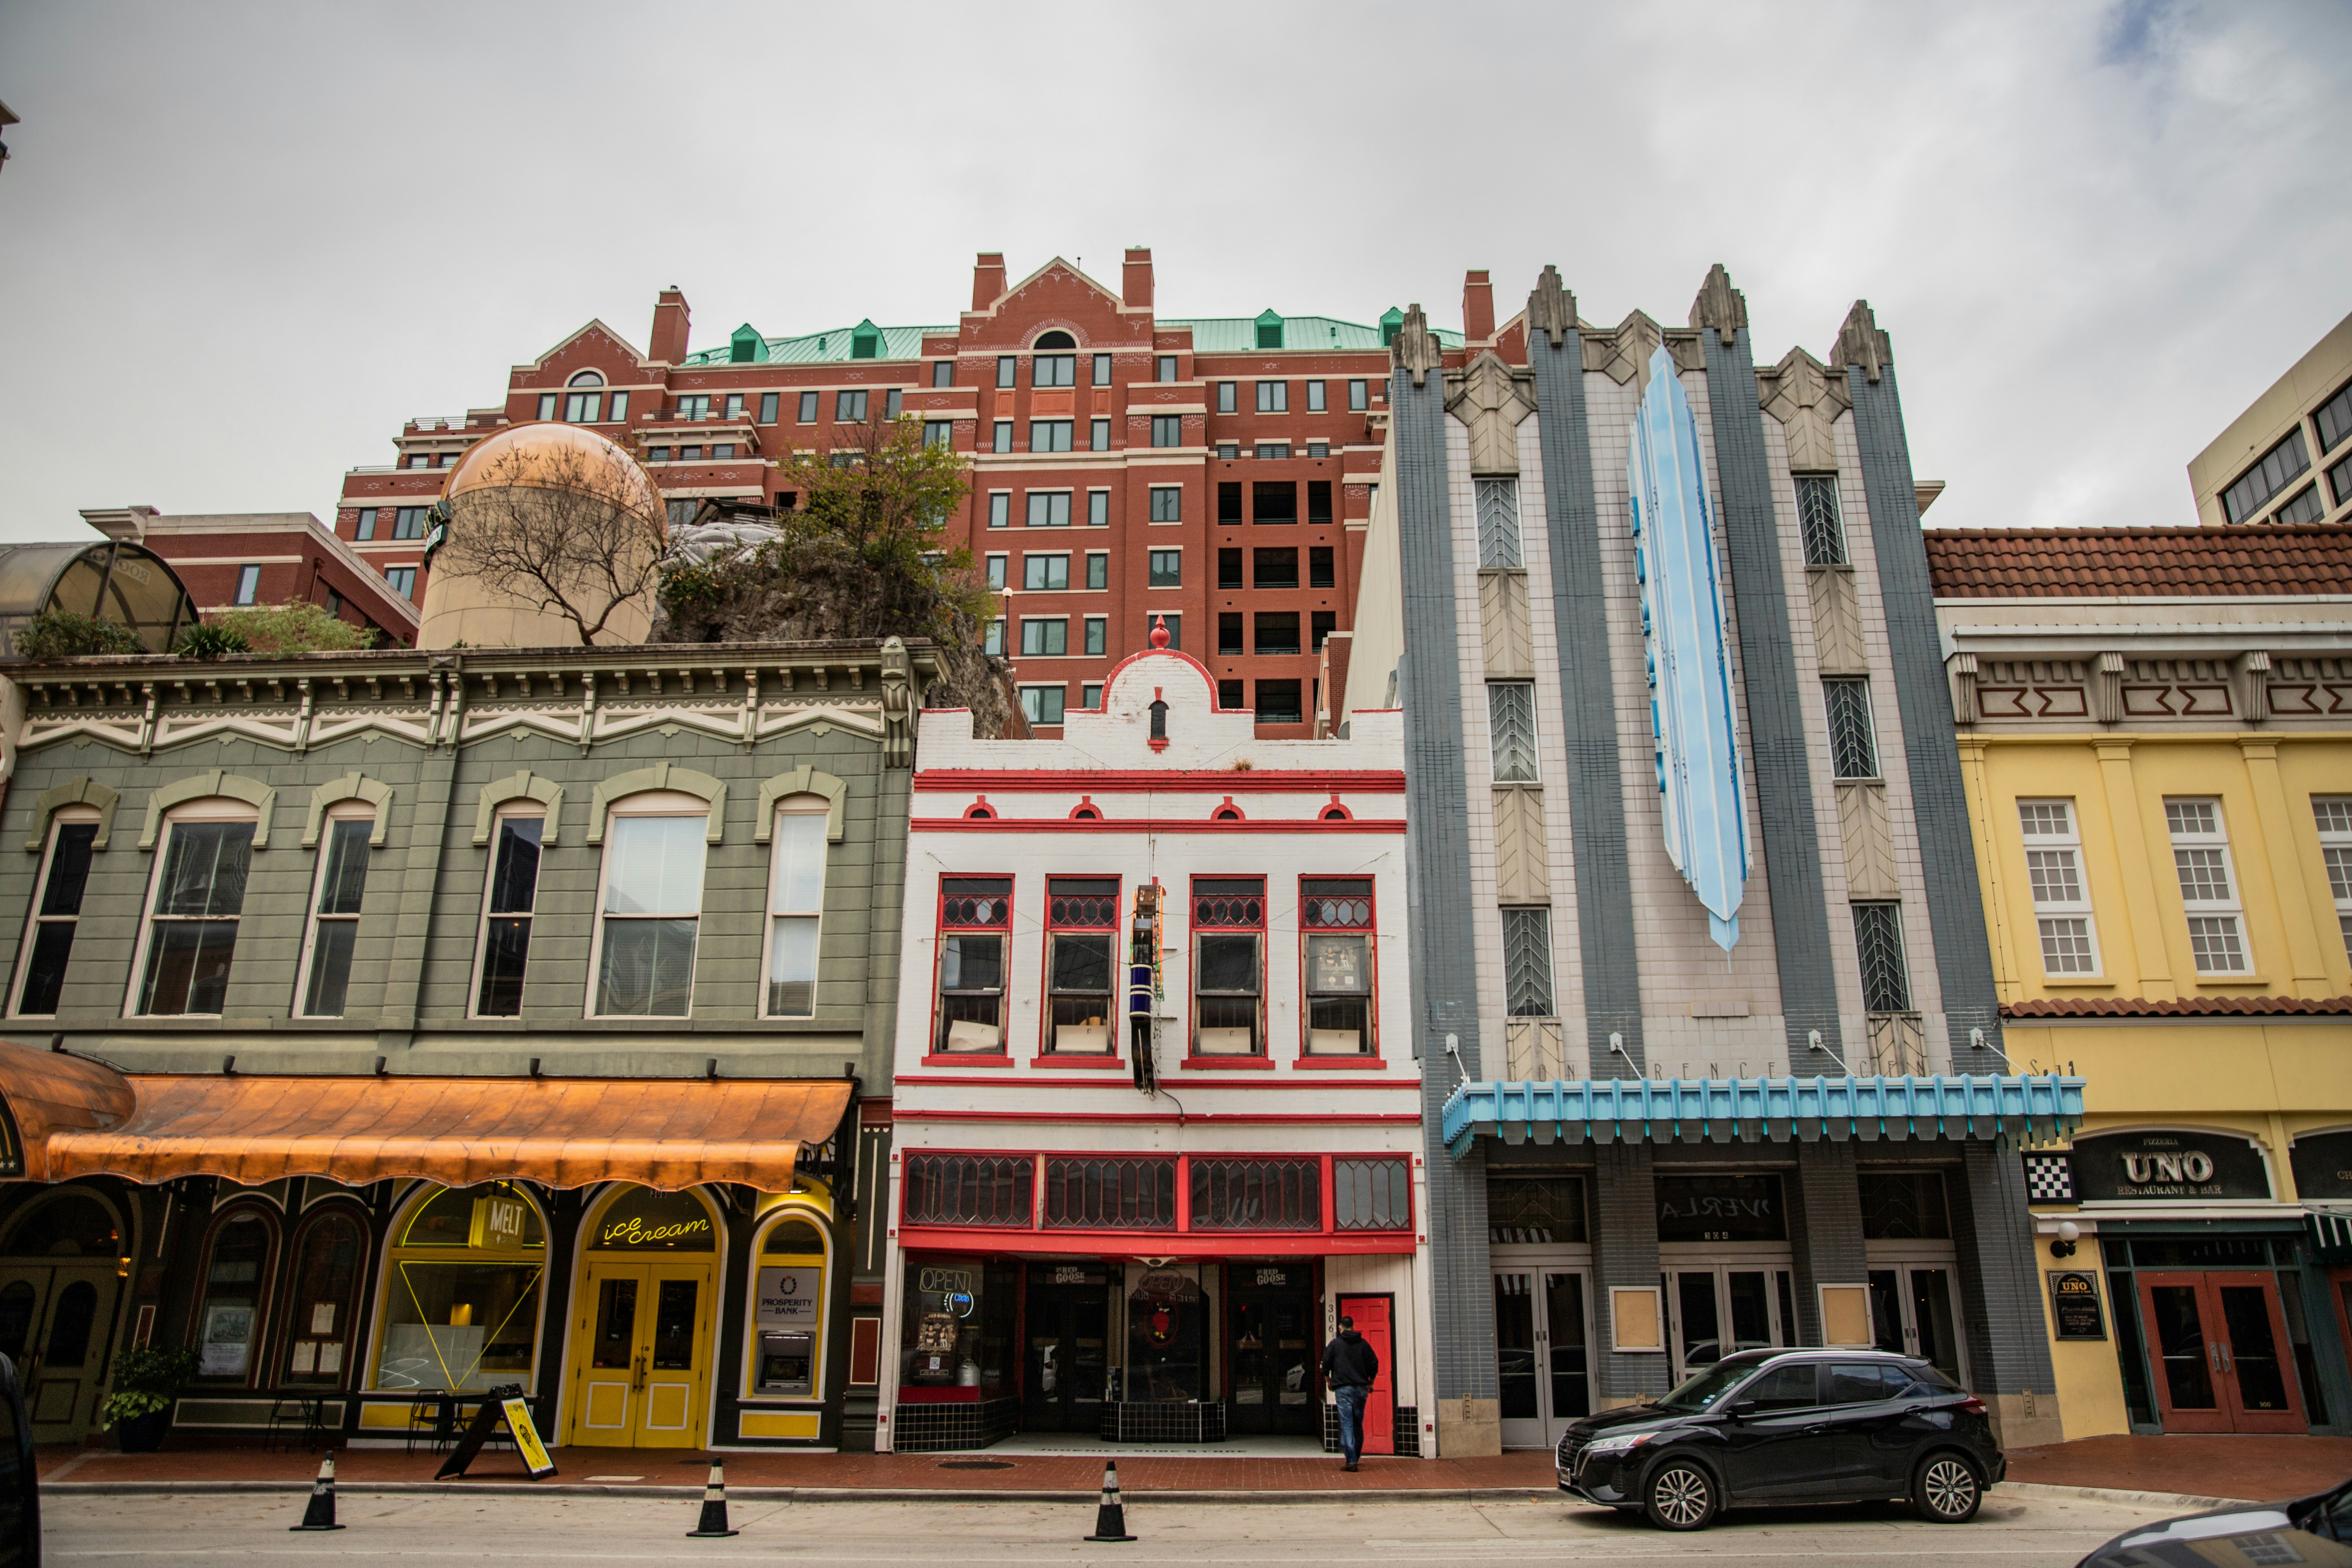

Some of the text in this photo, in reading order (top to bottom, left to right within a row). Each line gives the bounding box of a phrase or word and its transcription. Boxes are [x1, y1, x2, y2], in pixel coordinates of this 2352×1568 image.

[2121, 1150, 2214, 1183] UNO
[2117, 1185, 2222, 1195] RESTAURANT & BAR
[490, 1200, 524, 1236] MELT
[604, 1217, 642, 1240] ice
[628, 1219, 709, 1244] cream
[1704, 1231, 1729, 1240] 304
[922, 1269, 966, 1291] OPEN
[1056, 1272, 1085, 1284] GOOSE
[1141, 1275, 1180, 1290] OPEN
[1256, 1273, 1286, 1286] GOOSE
[2062, 1282, 2088, 1290] UNO
